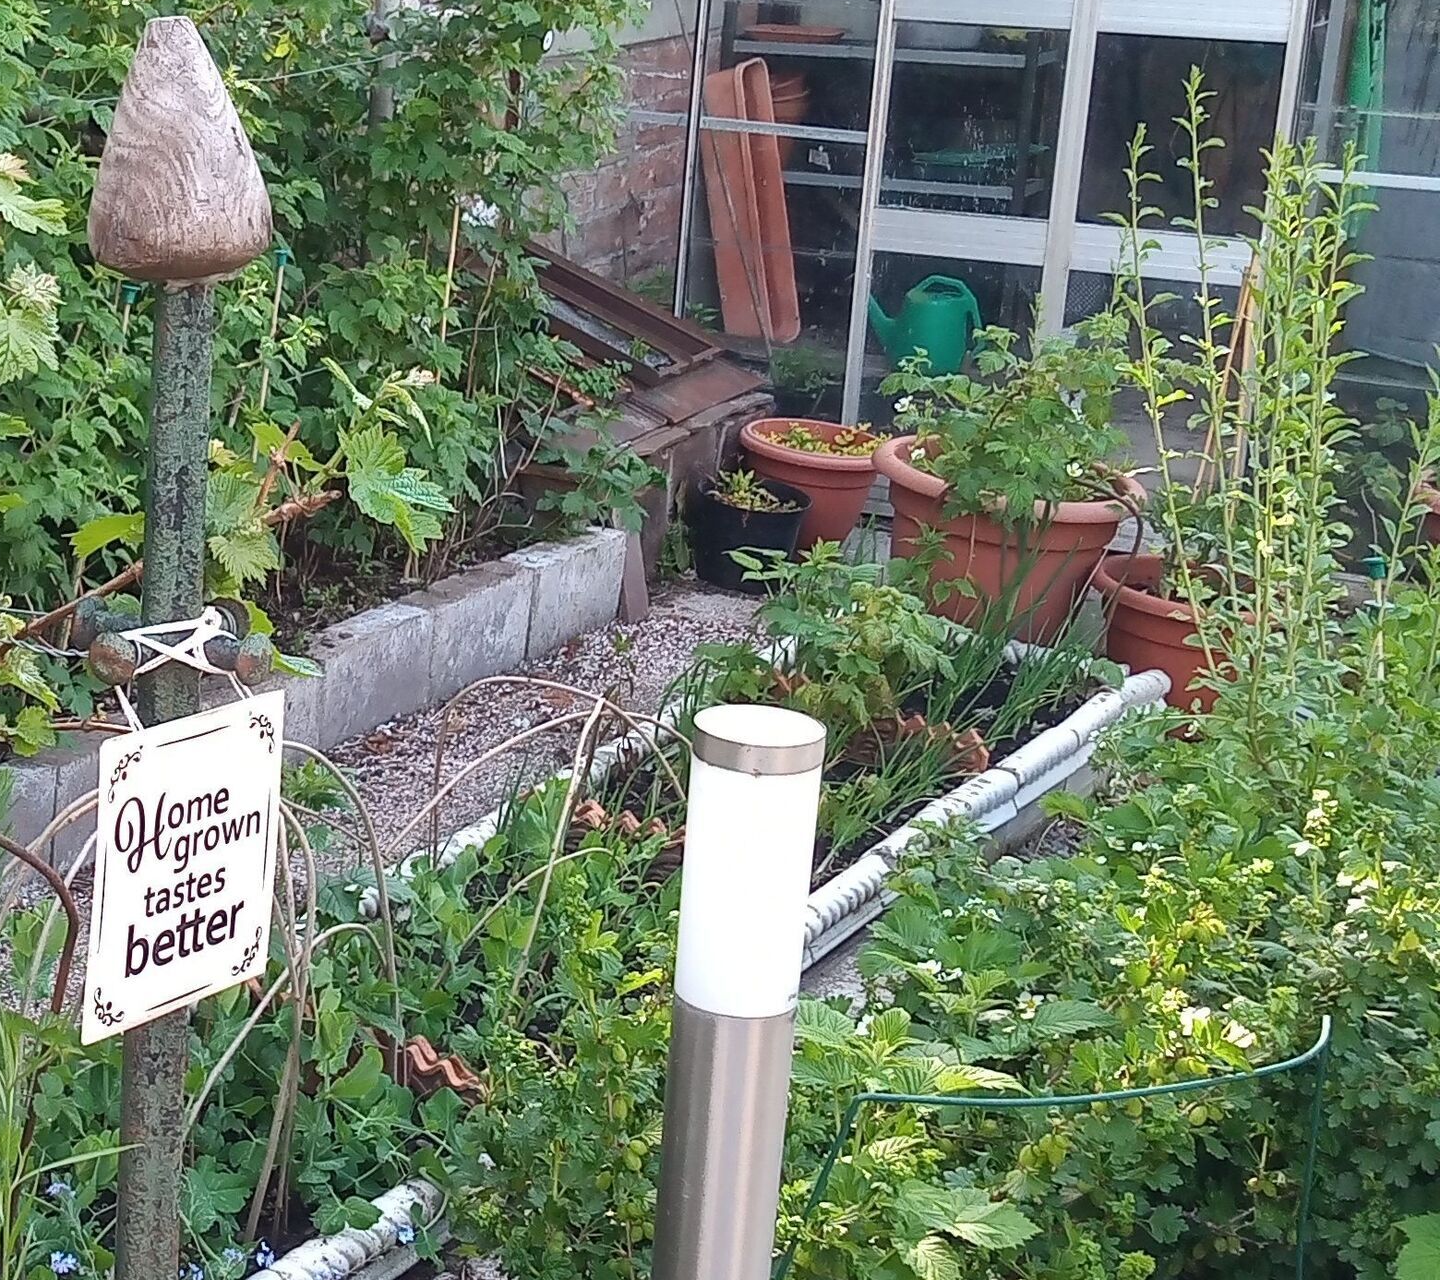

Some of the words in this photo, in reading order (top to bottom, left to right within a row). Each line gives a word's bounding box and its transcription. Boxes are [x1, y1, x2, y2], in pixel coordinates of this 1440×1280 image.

[114, 787, 230, 874] Home
[173, 810, 261, 874] grown
[143, 866, 226, 918] tastes
[124, 900, 245, 979] better
